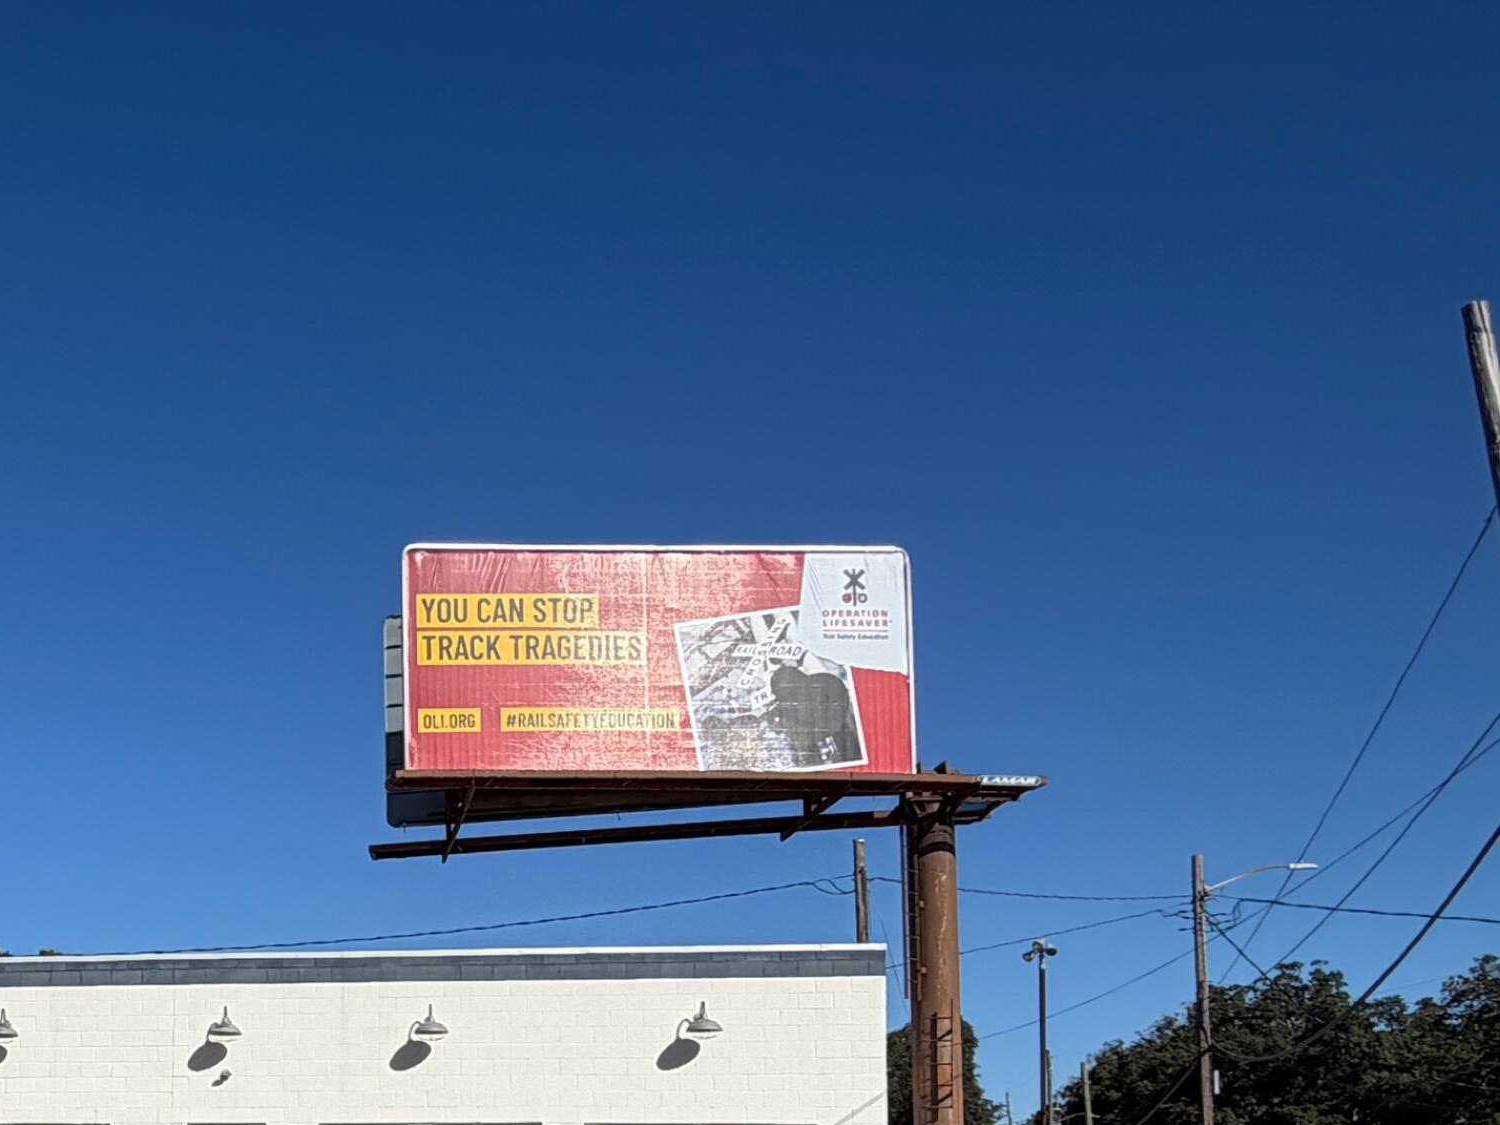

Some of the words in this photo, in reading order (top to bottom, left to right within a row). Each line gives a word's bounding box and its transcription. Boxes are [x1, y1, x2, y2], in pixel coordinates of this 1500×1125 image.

[422, 598, 468, 623] YOU
[477, 598, 524, 623] CAN
[533, 598, 594, 623] STOP
[822, 609, 888, 617] OPERATION
[422, 635, 501, 660] TRACK
[509, 635, 643, 661] TRAGEDIES
[423, 713, 476, 729] OLI.ORG
[506, 712, 675, 729] #RAILSAFETYEDUCATION
